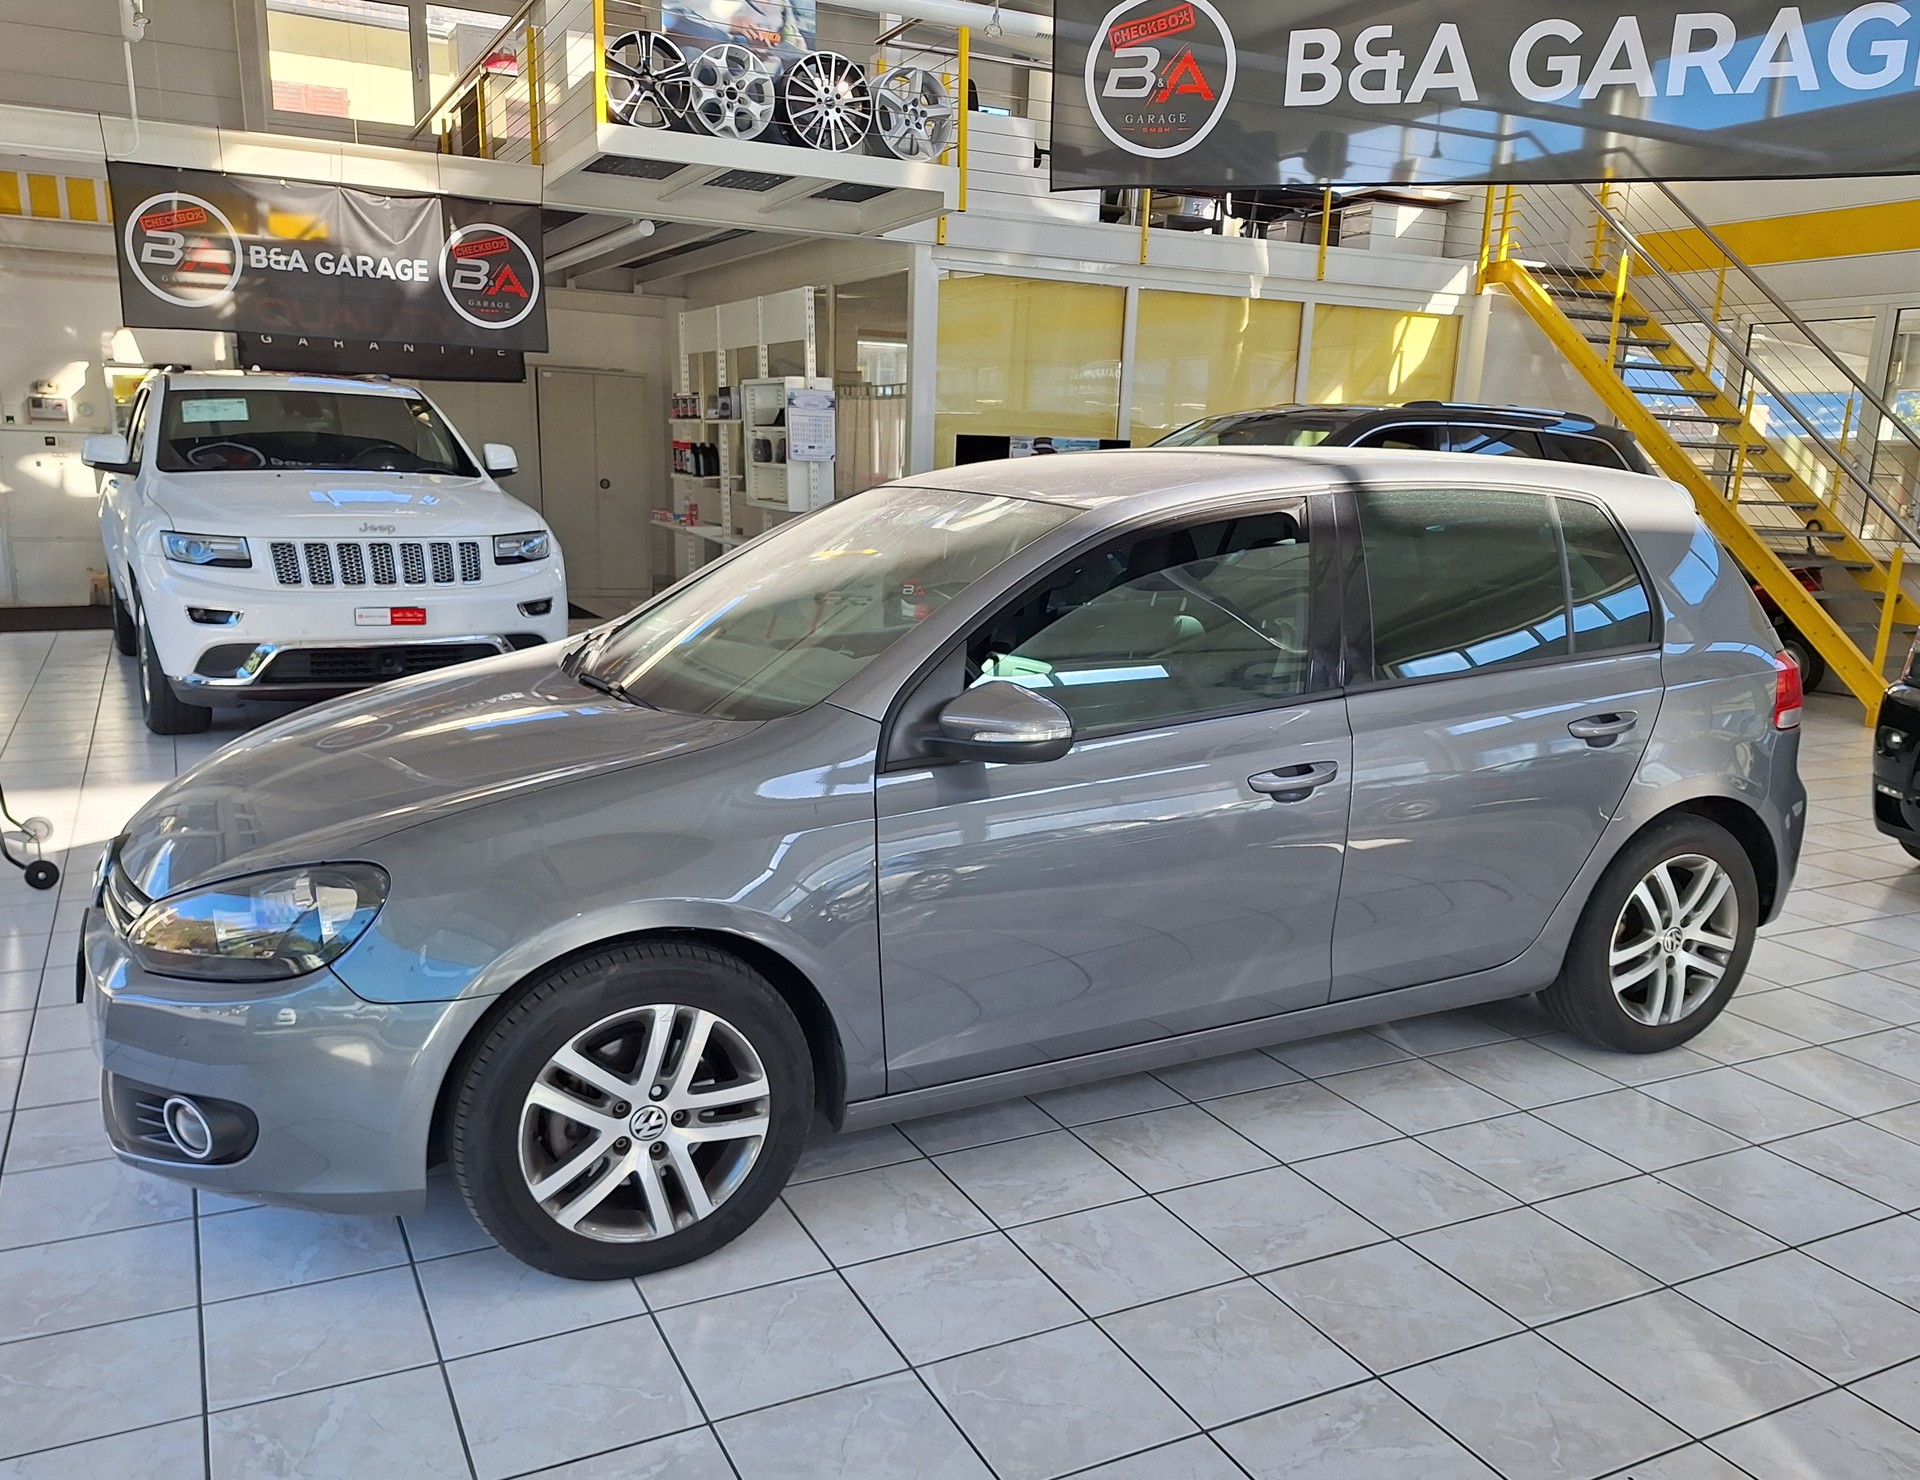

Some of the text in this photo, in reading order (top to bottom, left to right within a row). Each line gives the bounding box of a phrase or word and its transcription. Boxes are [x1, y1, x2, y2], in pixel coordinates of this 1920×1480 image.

[1113, 9, 1191, 44] CHECKBOX
[1282, 1, 1920, 107] B&A GARAG
[1125, 113, 1187, 124] GARAGE
[144, 211, 204, 228] CHECKBOX
[456, 240, 506, 256] CHECKBOX
[249, 245, 429, 282] B&A GARAGE
[468, 299, 511, 309] GARAGE
[359, 522, 396, 534] Jeep
